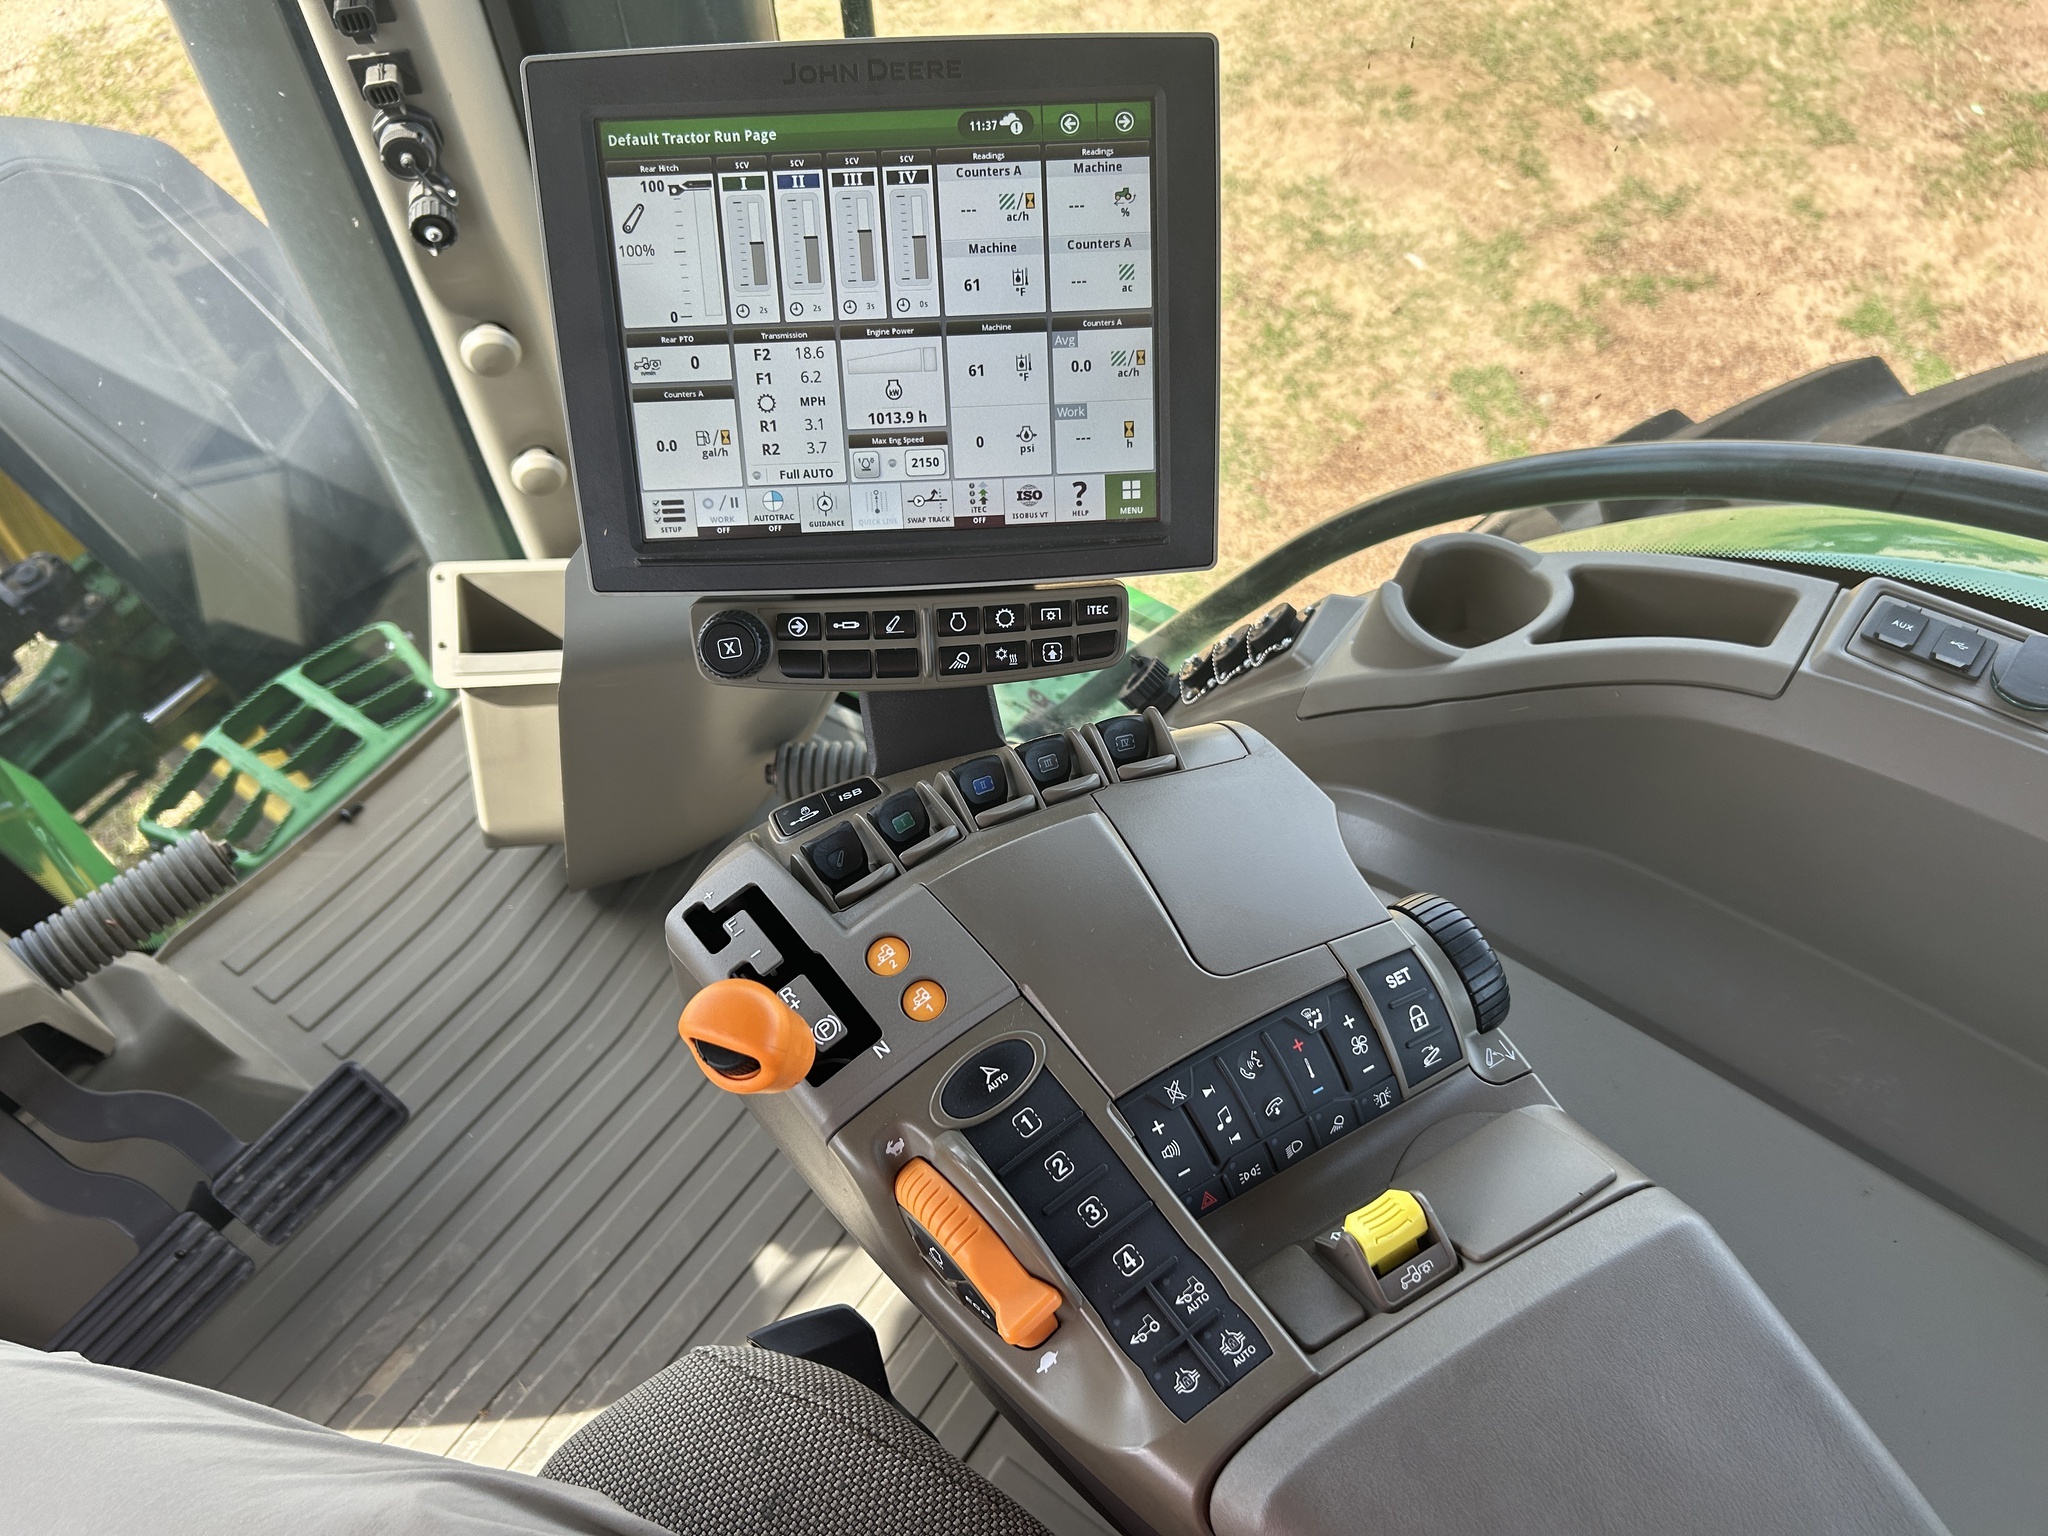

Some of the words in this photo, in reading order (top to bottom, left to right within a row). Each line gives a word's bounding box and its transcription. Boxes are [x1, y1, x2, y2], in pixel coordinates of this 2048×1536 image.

[782, 61, 859, 85] JOHN
[867, 59, 963, 82] DEERE
[969, 120, 998, 132] 11:37
[608, 132, 660, 147] Default
[662, 131, 711, 145] Tractor
[714, 130, 741, 143] Run
[744, 129, 777, 145] Page
[972, 152, 1005, 162] Readings
[1082, 148, 1115, 157] Readings
[790, 160, 805, 168] SCV
[845, 157, 860, 165] SCV
[900, 155, 915, 163] SCV
[640, 165, 657, 173] Rear
[658, 164, 680, 172] Hitch
[735, 162, 750, 170] SCV
[956, 165, 1011, 178] Counters
[1013, 165, 1022, 176] A
[1073, 161, 1123, 173] Machine
[739, 177, 748, 190] I
[791, 175, 806, 188] II
[843, 173, 863, 186] III
[898, 171, 918, 184] IV
[640, 180, 665, 193] 100
[1006, 211, 1029, 222] ac/h
[968, 242, 1017, 254] Machine
[1067, 238, 1121, 250] Counters
[1123, 237, 1132, 248] A
[619, 244, 655, 257] 100%
[963, 278, 980, 292] 61
[1121, 284, 1133, 293] ac
[759, 306, 768, 314] 2s
[813, 304, 822, 312] 2s
[866, 302, 875, 310] 3s
[919, 300, 928, 308] 0s
[670, 311, 678, 323] 0
[1083, 319, 1115, 328] Counters
[1116, 318, 1123, 326] A
[866, 329, 890, 338] Engine
[891, 327, 914, 336] Power
[982, 323, 1012, 331] Machine
[661, 336, 678, 344] Rear
[679, 335, 694, 343] PTO
[761, 331, 808, 340] Transmission
[1054, 335, 1076, 347] Avg
[753, 348, 772, 361] F2
[795, 346, 825, 360] 18.6
[690, 356, 700, 370] 0
[1071, 360, 1092, 373] 0.0
[968, 364, 984, 377] 61
[1117, 367, 1140, 378] ac/h
[756, 373, 773, 385] F1
[800, 370, 822, 383] 6.2
[664, 390, 697, 399] Counters
[698, 390, 704, 398] A
[800, 397, 826, 407] MPH
[868, 411, 914, 425] 1013.9
[918, 410, 927, 423] h
[1056, 406, 1085, 417] Work
[760, 420, 777, 432] R1
[805, 418, 824, 431] 3.1
[656, 440, 678, 453] 0.0
[871, 437, 887, 445] Max
[889, 437, 902, 445] Eng
[903, 436, 925, 445] Speed
[976, 436, 984, 448] 0
[1126, 439, 1133, 448] h
[702, 448, 729, 460] gal/h
[762, 443, 780, 456] R2
[807, 441, 827, 454] 3.7
[1020, 444, 1035, 455] psi
[911, 457, 940, 468] 2150
[779, 469, 800, 480] Full
[803, 468, 834, 479] AUTO
[1016, 489, 1043, 501] ISO
[1040, 511, 1048, 519] VT
[1120, 506, 1143, 515] MENU
[754, 514, 795, 522] AUTOTRAC
[973, 516, 987, 525] OFF
[661, 526, 682, 534] SETUP
[717, 526, 731, 534] OFF
[768, 524, 783, 532] OFF
[1086, 604, 1109, 616] iTEC
[1891, 619, 1915, 632] AUX
[723, 642, 736, 655] X
[838, 787, 863, 802] ISB
[889, 959, 898, 969] 2
[1385, 966, 1411, 989] SET
[925, 1003, 934, 1012] 1
[819, 1021, 832, 1038] P
[872, 1040, 891, 1059] N
[987, 1072, 1009, 1093] AUTO
[1020, 1115, 1034, 1130] 1
[1051, 1157, 1069, 1176] 2
[1085, 1203, 1101, 1221] 3
[1122, 1250, 1137, 1269] 4
[1186, 1292, 1210, 1315] AUTO
[1232, 1344, 1257, 1368] AUTO
